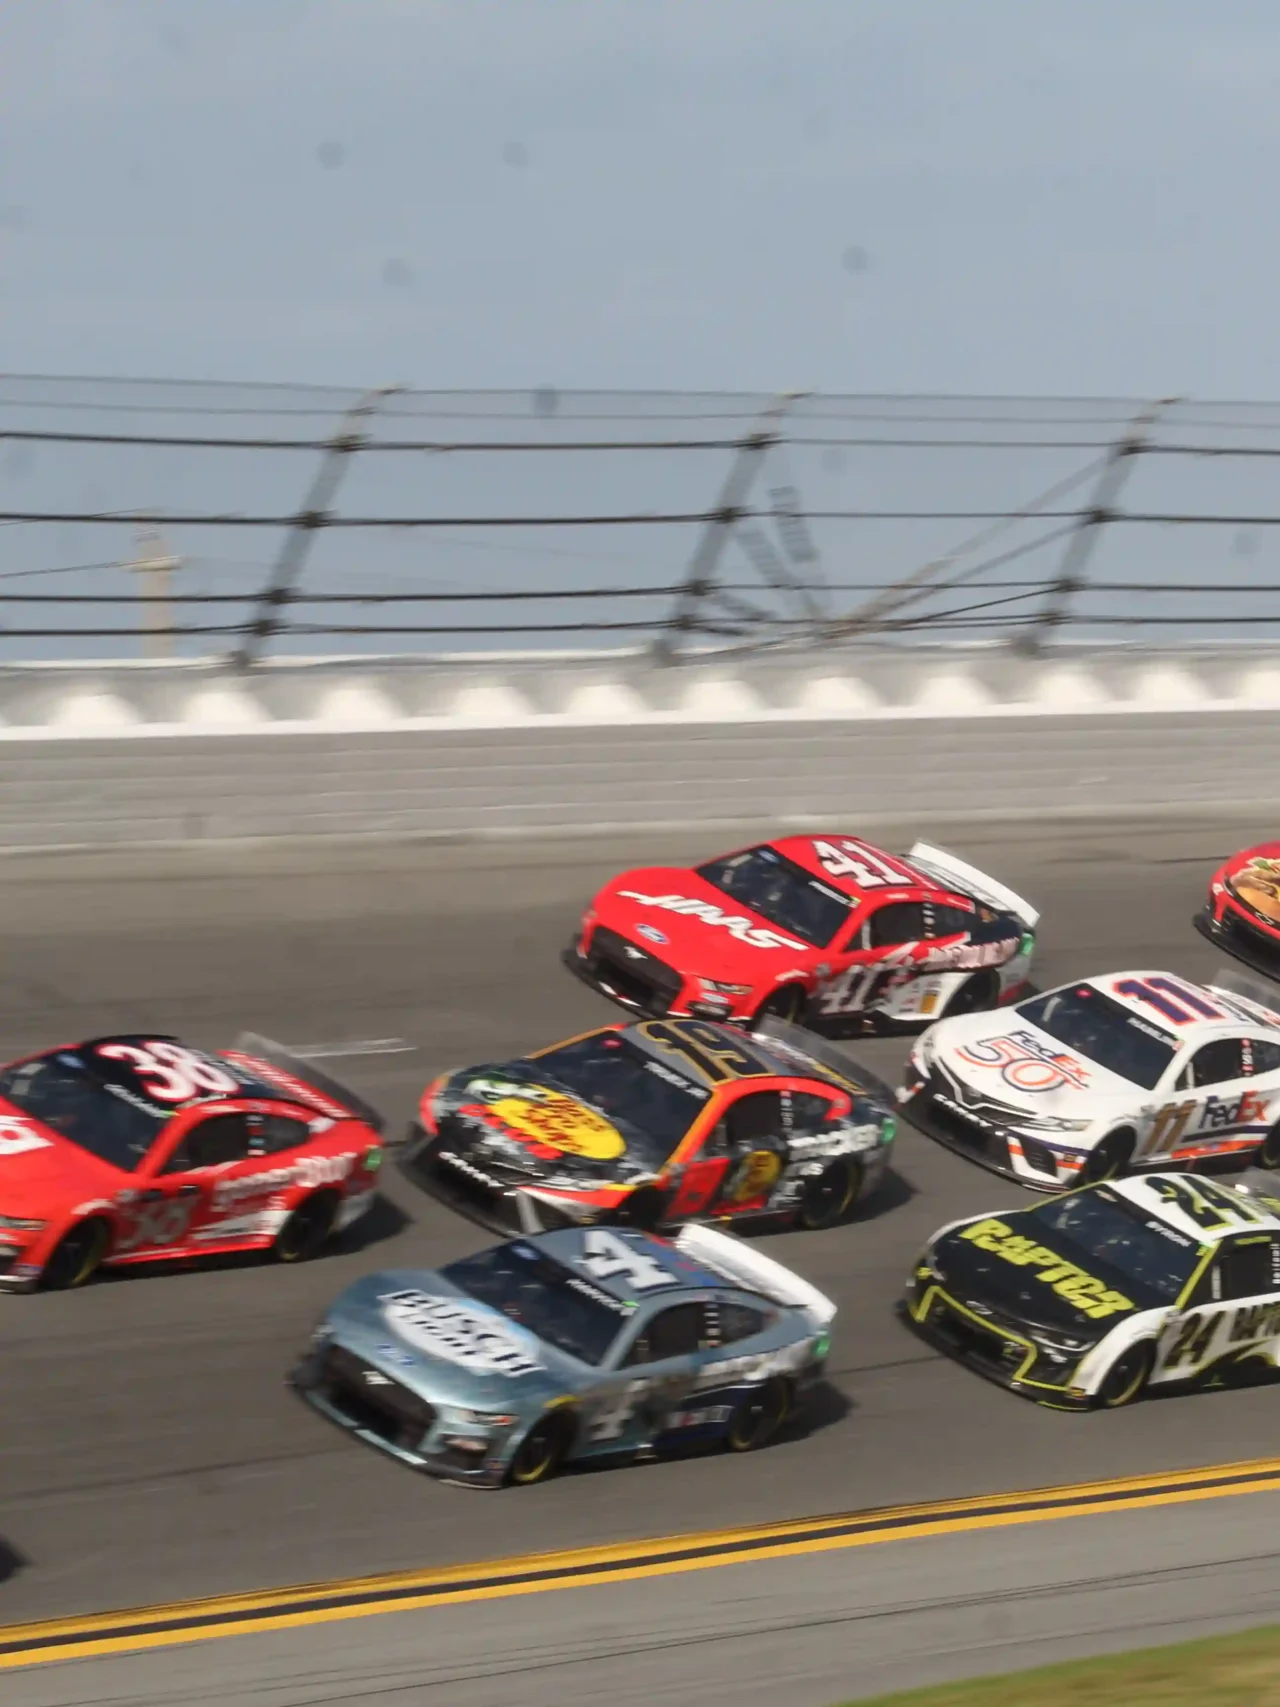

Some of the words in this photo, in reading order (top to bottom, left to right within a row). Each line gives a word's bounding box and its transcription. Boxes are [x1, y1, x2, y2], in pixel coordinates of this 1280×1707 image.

[811, 839, 917, 890] 41
[1112, 977, 1227, 1027] 11
[97, 1042, 242, 1102] 38
[1008, 1030, 1093, 1077] FedEx
[1144, 1098, 1198, 1155] 11
[1198, 1090, 1269, 1129] FedEx
[579, 1229, 681, 1290] 4
[957, 1218, 1136, 1319] RAPTOR
[377, 1289, 547, 1378] BUSCH
[1162, 1310, 1228, 1369] 24
